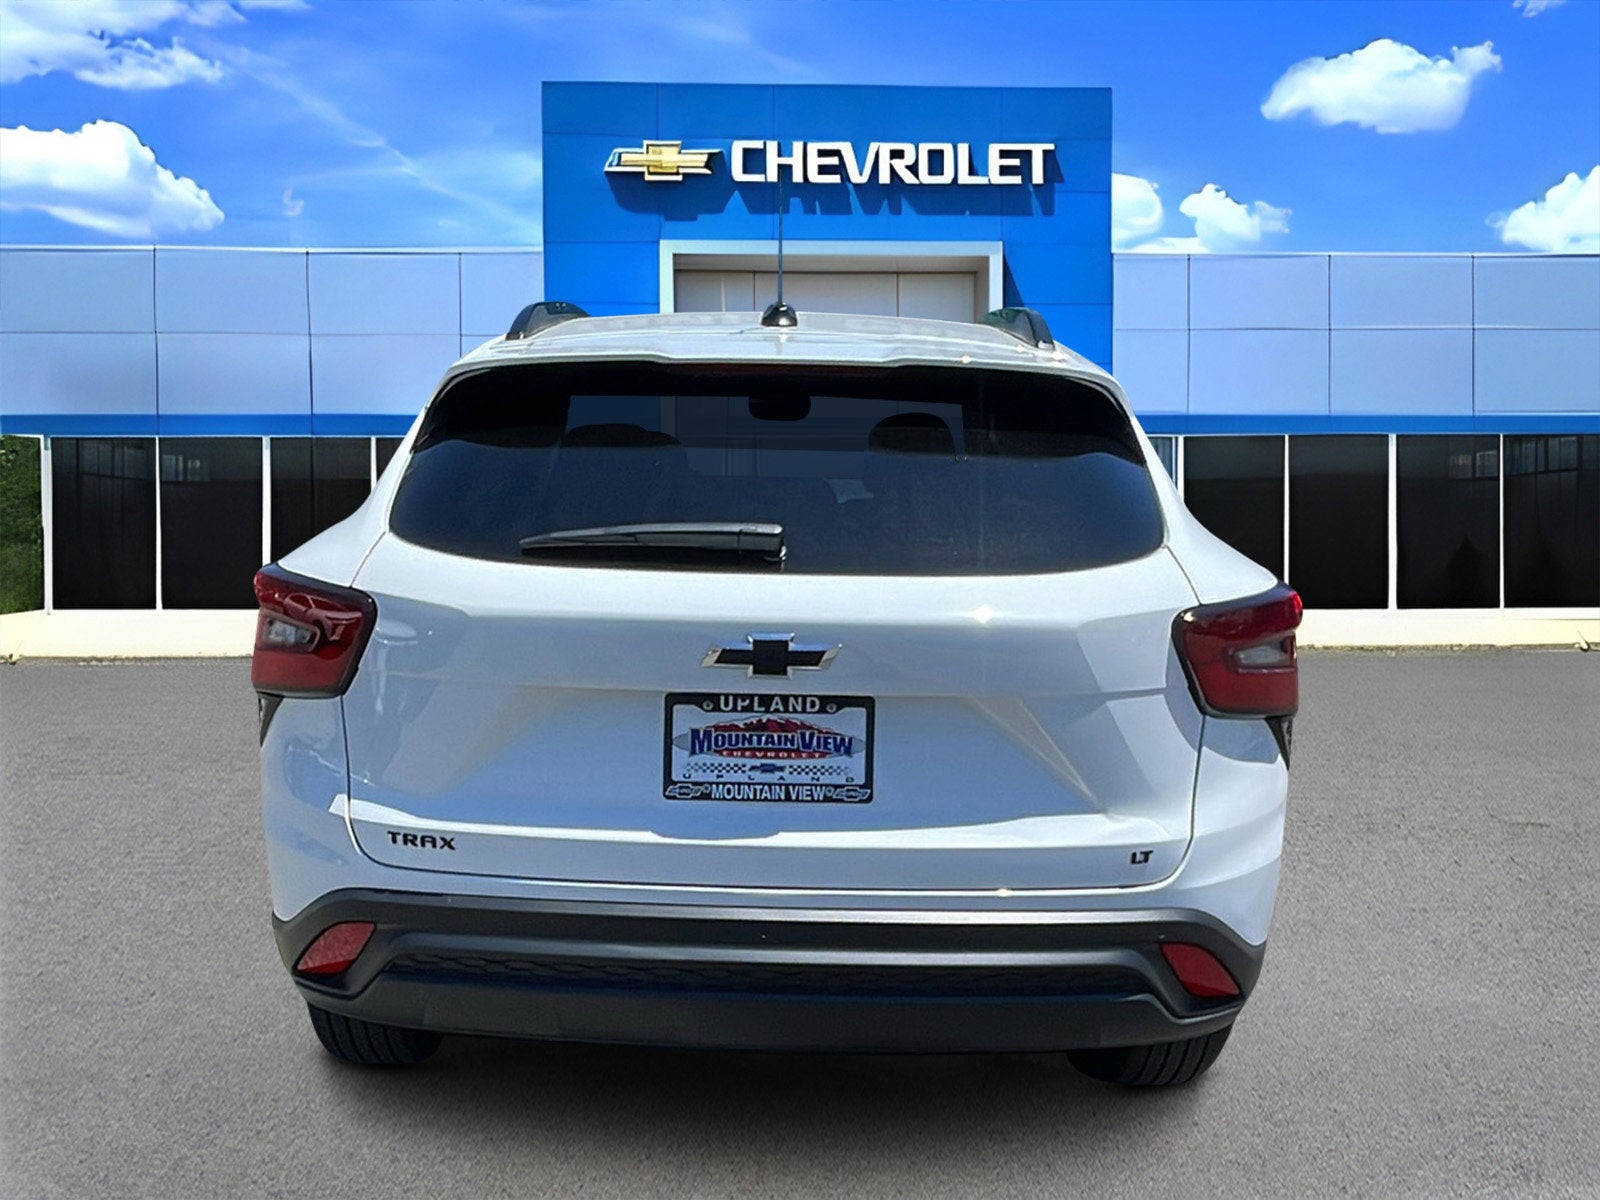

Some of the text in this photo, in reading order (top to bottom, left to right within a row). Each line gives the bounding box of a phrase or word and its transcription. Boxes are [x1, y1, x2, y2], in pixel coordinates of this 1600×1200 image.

[731, 140, 1055, 185] CHEVROLET
[719, 695, 820, 712] UPLAND
[711, 785, 826, 801] MOUNTAIN VIEW
[387, 830, 455, 850] TRAX
[1131, 850, 1154, 865] LT
